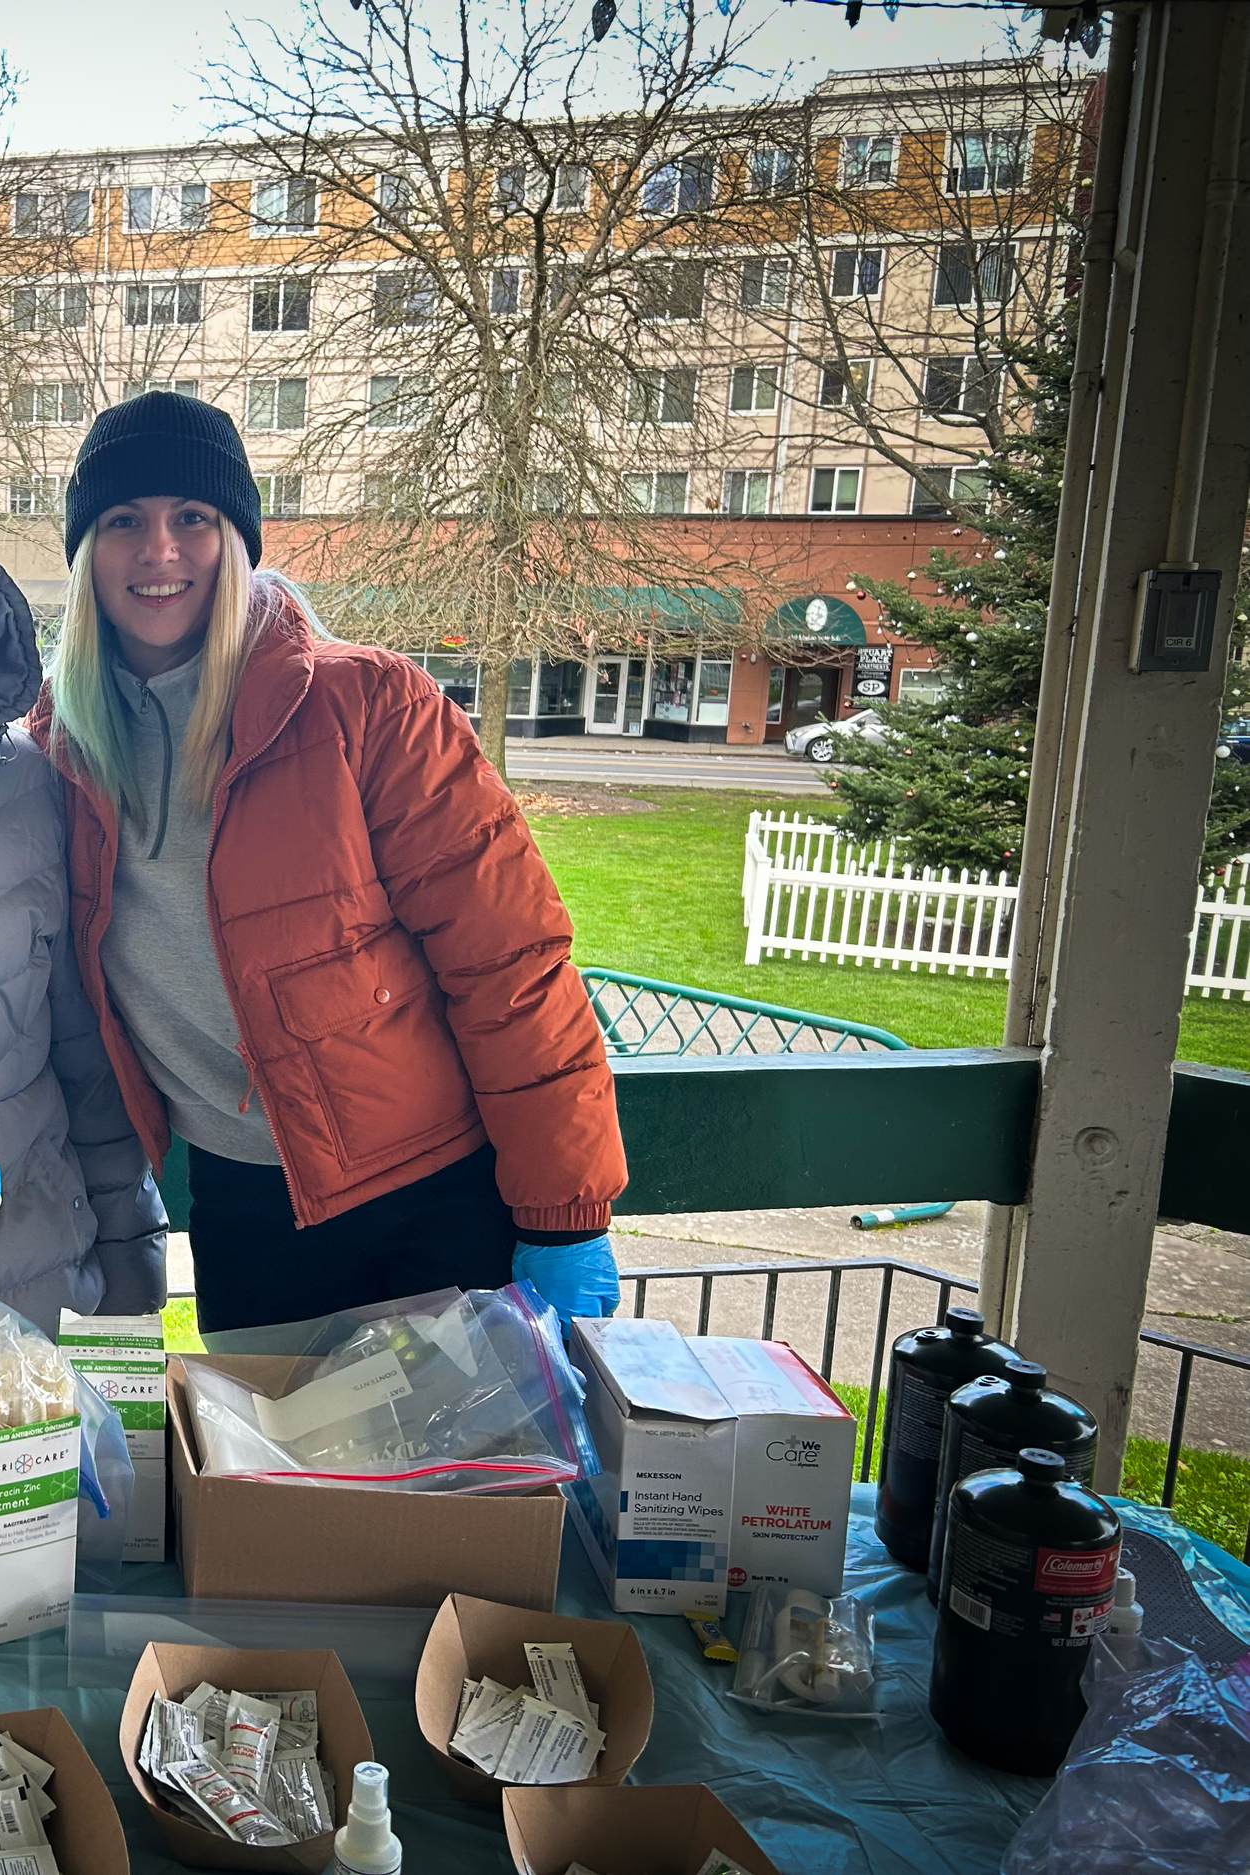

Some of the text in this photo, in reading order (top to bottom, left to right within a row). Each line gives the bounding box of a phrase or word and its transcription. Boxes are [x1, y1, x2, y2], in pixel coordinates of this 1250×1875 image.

[1166, 638, 1192, 646] CIR 6
[857, 648, 893, 657] STUART
[860, 656, 889, 664] PLACE
[862, 682, 880, 692] SP
[352, 1370, 397, 1391] CONTENTS
[121, 1386, 153, 1394] CARE
[0, 1434, 10, 1442] AID
[11, 1428, 43, 1440] ANTIBIOTIC
[44, 1421, 74, 1433] OINTMENT
[802, 1441, 821, 1450] We
[766, 1441, 818, 1462] Care
[35, 1451, 65, 1465] CARE
[23, 1482, 41, 1494] Zinc
[635, 1491, 702, 1502] Instant Hand
[634, 1504, 724, 1517] Sanitizing Wipes
[766, 1505, 811, 1517] WHITE
[3, 1513, 49, 1528] BACITRACIN ZINC
[741, 1515, 832, 1530] PETROLATUM
[771, 1533, 819, 1541] PROTECTANT
[1049, 1558, 1094, 1571] Coleman
[637, 1587, 645, 1595] in
[653, 1588, 666, 1596] 6.7
[668, 1588, 676, 1596] in
[1052, 1637, 1088, 1647] NET WEIGHT
